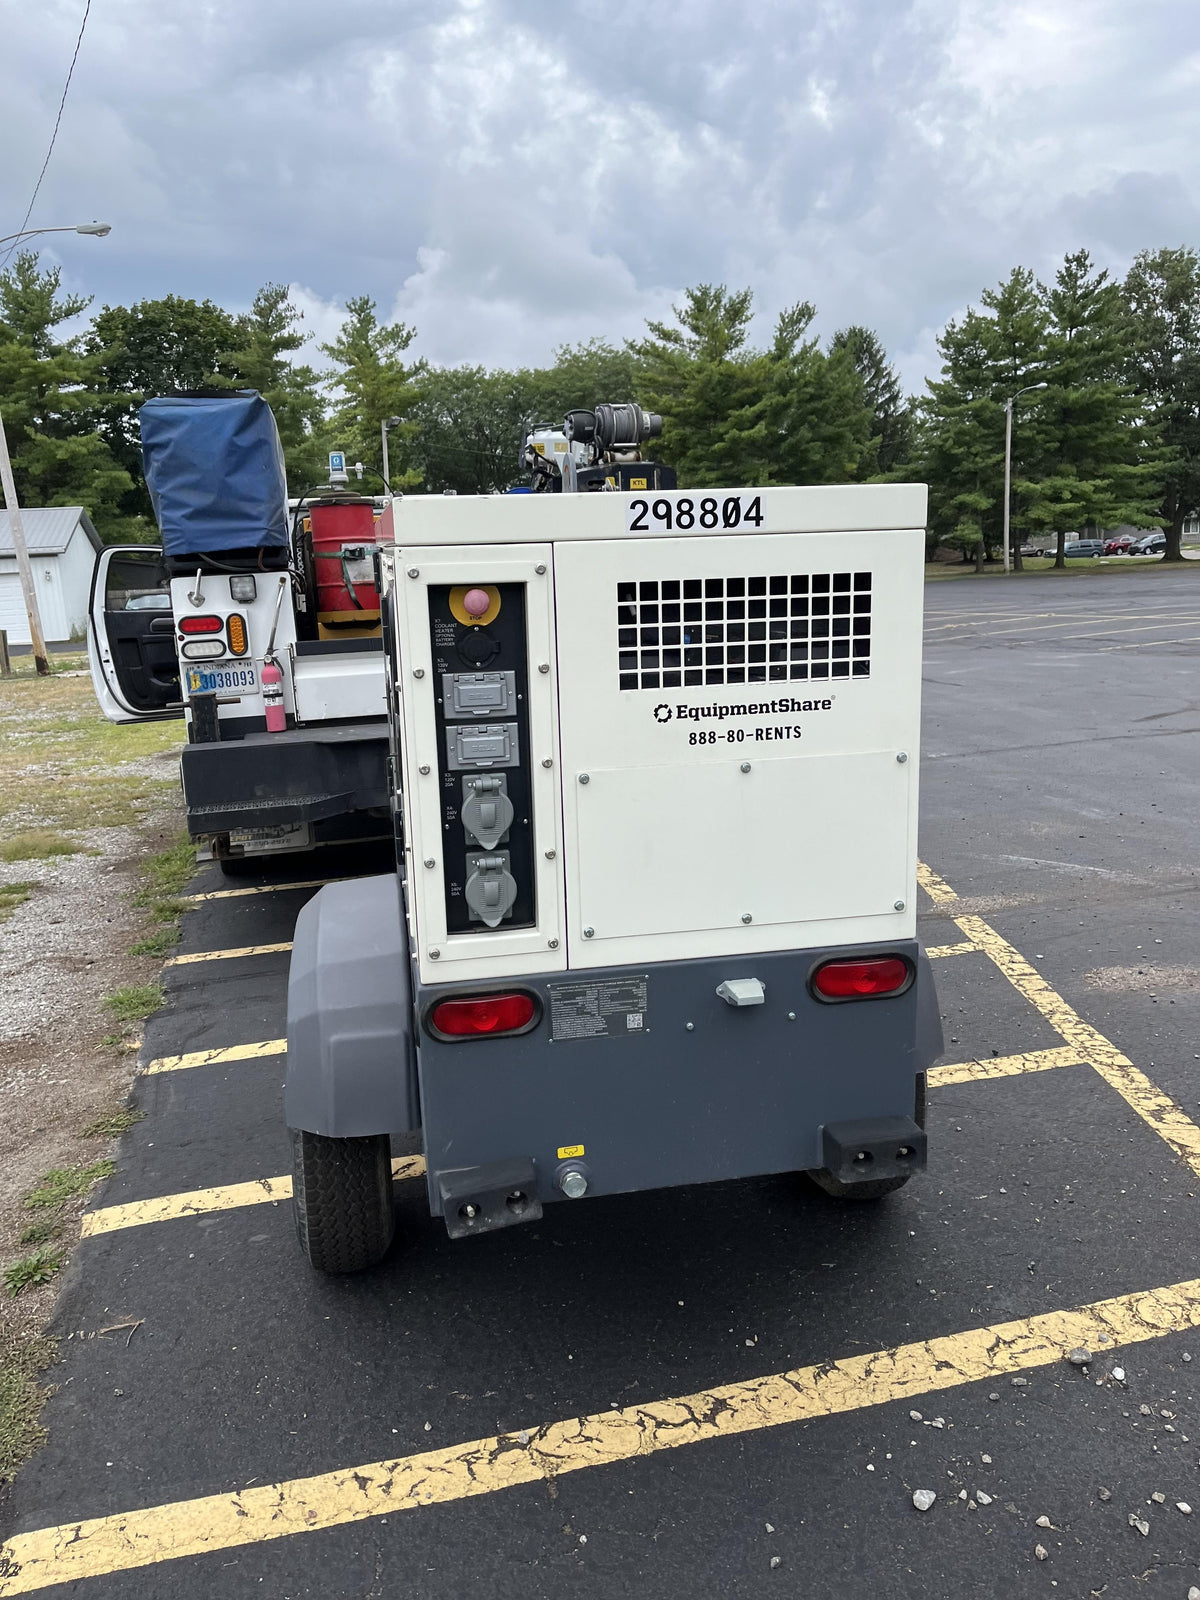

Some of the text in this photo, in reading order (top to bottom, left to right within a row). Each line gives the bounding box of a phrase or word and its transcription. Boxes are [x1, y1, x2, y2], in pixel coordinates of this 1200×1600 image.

[203, 662, 236, 671] INDIANA
[202, 670, 255, 690] 3038093
[676, 698, 832, 721] EquipmentShare
[688, 725, 802, 745] 888-80-RENTS
